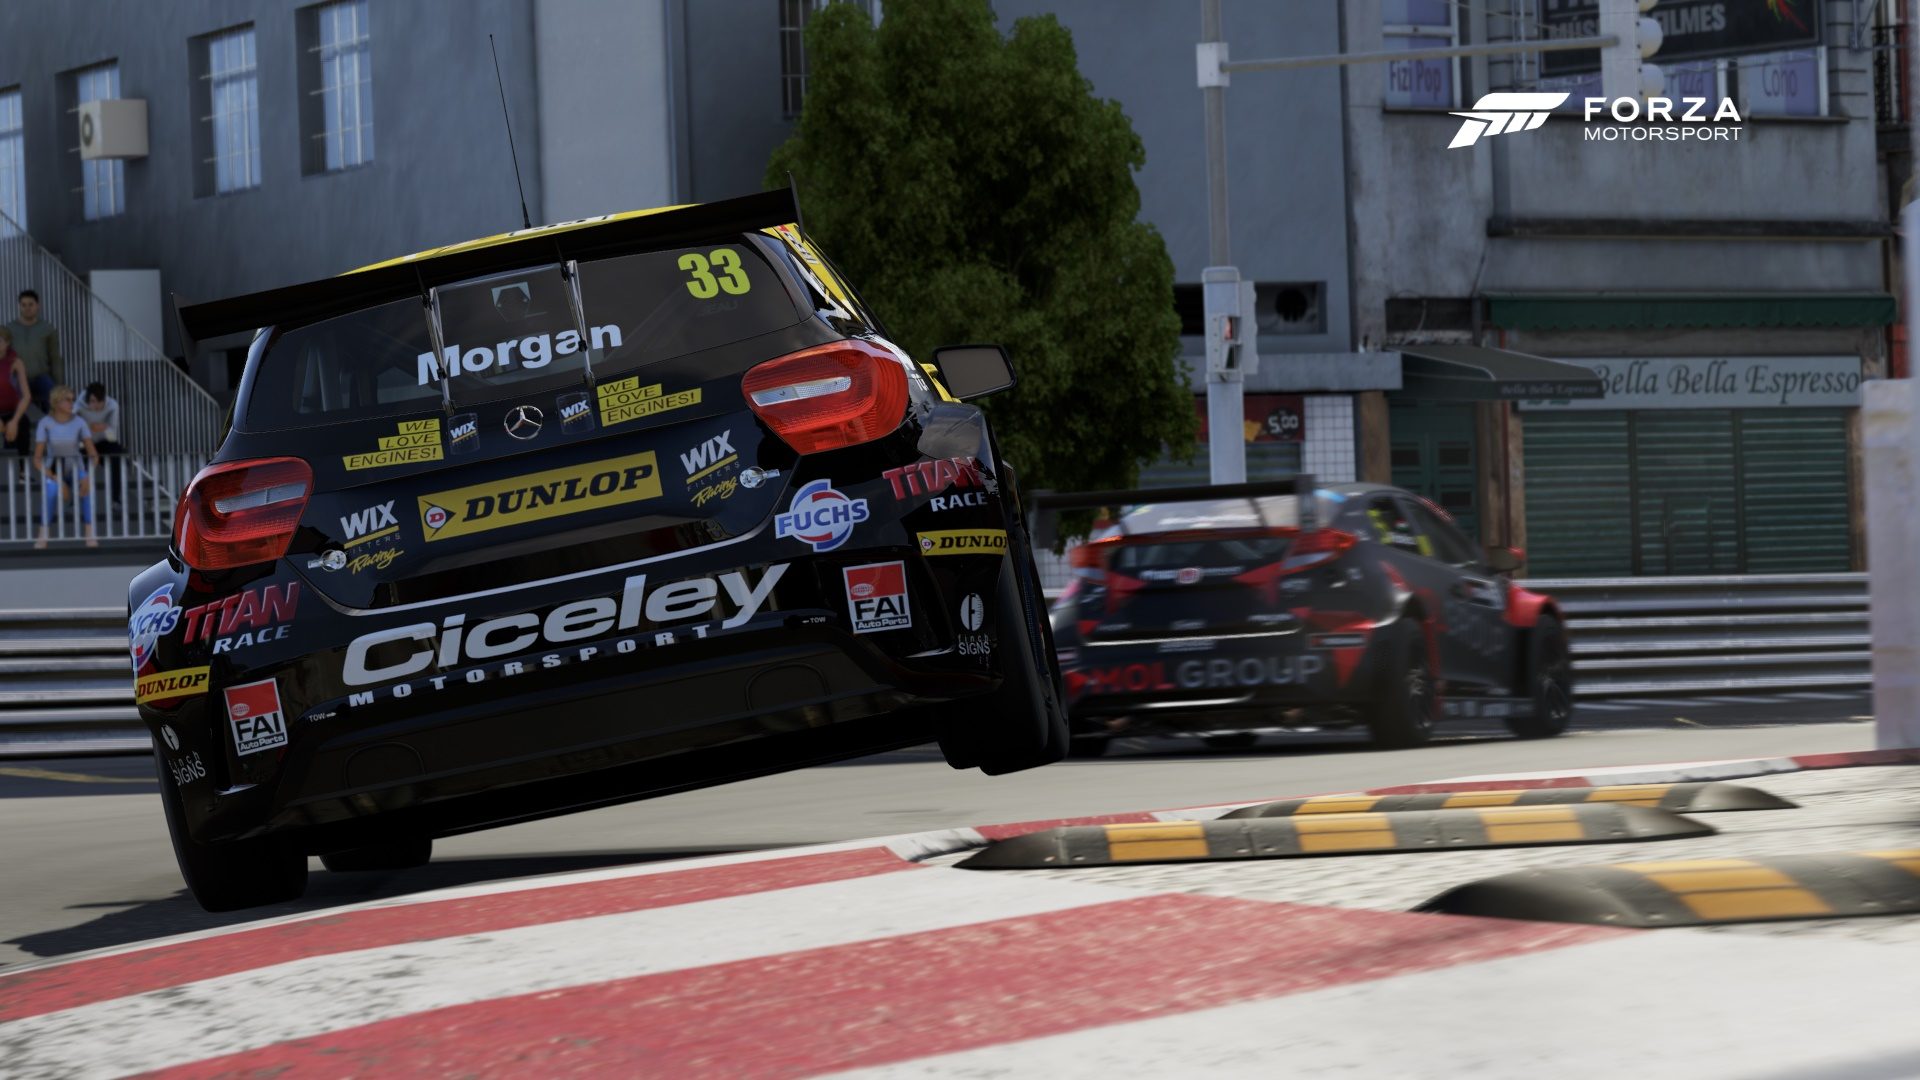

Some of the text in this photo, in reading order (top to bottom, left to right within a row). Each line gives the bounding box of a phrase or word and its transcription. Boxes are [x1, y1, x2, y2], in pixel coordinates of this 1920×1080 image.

[677, 247, 752, 300] 33
[416, 323, 623, 387] Morgan
[602, 379, 633, 394] WE
[1667, 360, 1738, 395] Bella
[1744, 362, 1860, 404] Espresso
[560, 399, 590, 418] WIX
[605, 387, 656, 408] LOVE
[607, 392, 695, 423] ENGINES!
[405, 420, 435, 432] WE
[450, 420, 477, 439] WIX
[384, 433, 436, 448] LOVE
[680, 429, 737, 475] WIX
[349, 447, 438, 469] ENGINES!
[461, 464, 654, 523] DUNLOP
[690, 476, 738, 508] Racing
[930, 491, 989, 513] RACE
[340, 499, 399, 540] WIX
[778, 501, 867, 536] FUCHS
[939, 535, 1008, 549] DUNLO
[346, 547, 405, 575] Racing
[809, 616, 827, 624] TOW
[855, 595, 905, 620] FAI
[342, 562, 792, 687] Ciceley
[212, 624, 293, 655] RACE
[958, 641, 991, 655] SIGNS
[348, 623, 711, 708] MOTORSPORT
[137, 673, 207, 698] DUNLOP
[235, 712, 282, 742] FAI
[308, 712, 326, 723] TOW
[172, 760, 206, 787] SIGNS
